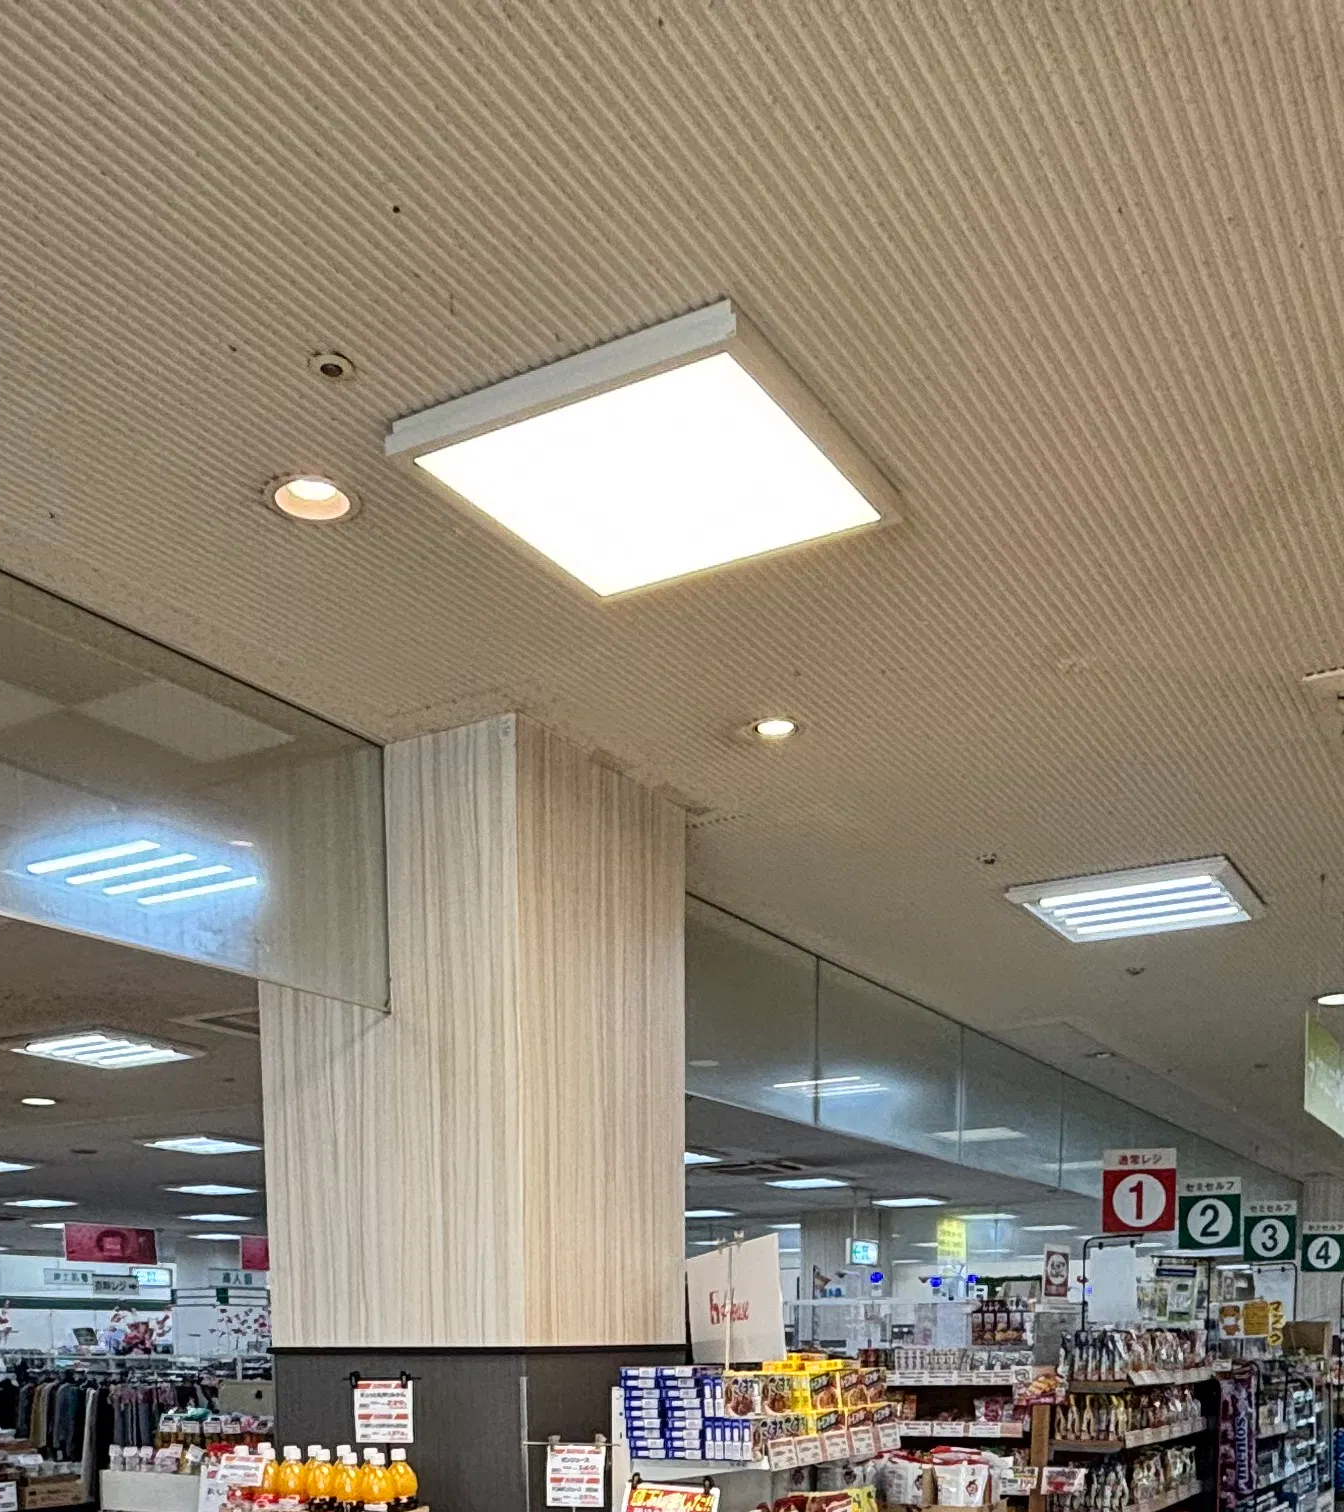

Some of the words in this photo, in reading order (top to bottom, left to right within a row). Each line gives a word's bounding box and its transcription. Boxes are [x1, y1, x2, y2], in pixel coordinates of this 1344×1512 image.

[1118, 1154, 1162, 1166] 通常レジ
[1185, 1180, 1235, 1193] セミセルフ
[1128, 1180, 1144, 1221] 1
[1250, 1202, 1292, 1214] セミセルフ
[1199, 1203, 1220, 1238] 2
[1260, 1224, 1279, 1252] 3
[1315, 1240, 1332, 1266] 4
[1235, 1416, 1248, 1483] mentos
